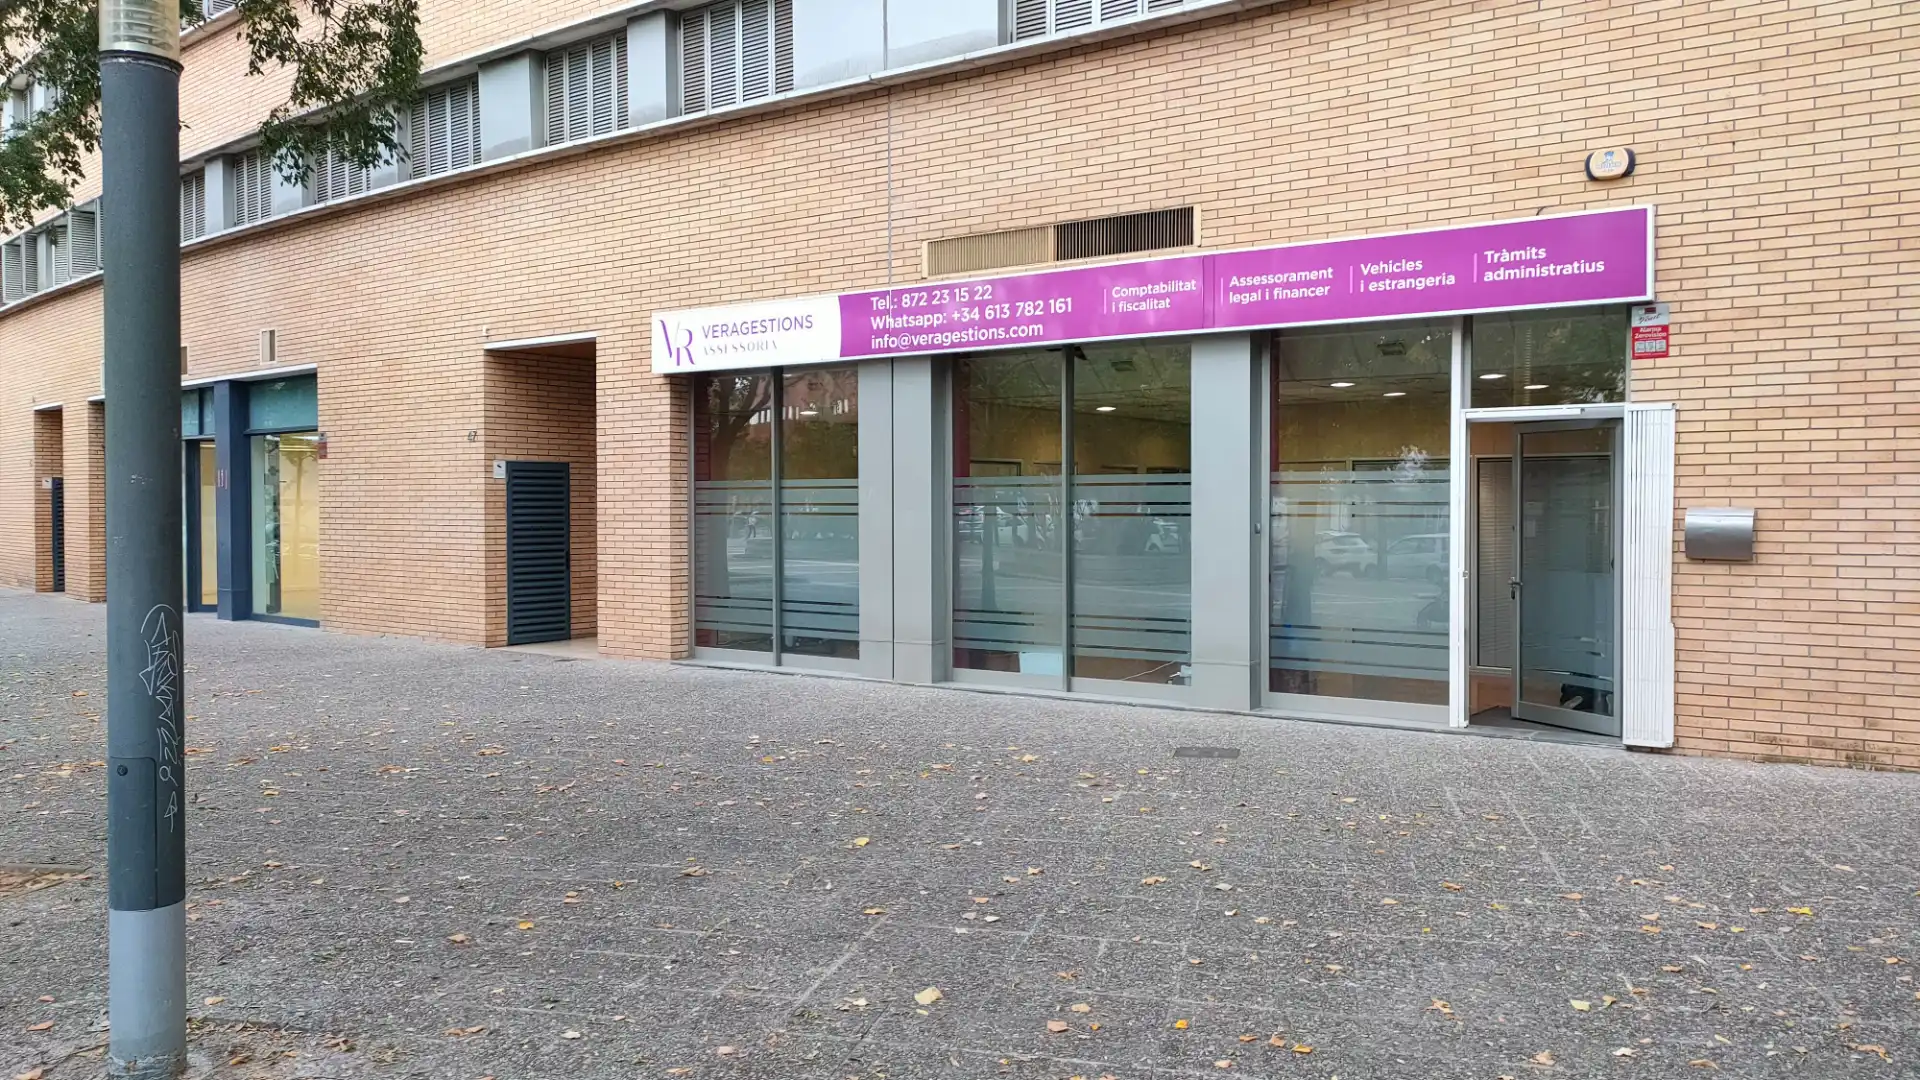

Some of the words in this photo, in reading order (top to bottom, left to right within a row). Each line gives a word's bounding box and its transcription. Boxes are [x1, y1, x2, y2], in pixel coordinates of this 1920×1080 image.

[1483, 247, 1547, 264] Tràmits
[1229, 267, 1334, 288] Assessorament
[1360, 259, 1423, 276] Vehicles
[1483, 260, 1605, 282] administratius
[1111, 279, 1197, 299] Comptabilitat
[1360, 279, 1365, 293] i
[1368, 271, 1456, 292] estrangeria
[901, 291, 928, 308] 872
[931, 289, 950, 305] 23
[953, 287, 969, 302] 15
[973, 284, 993, 300] 22
[1111, 300, 1116, 313] i
[1118, 297, 1171, 313] fiscalitat
[1229, 289, 1262, 305] legal
[1265, 287, 1270, 301] i
[1273, 284, 1331, 300] financer
[870, 312, 947, 330] Whatsapp:
[951, 306, 981, 322] +34
[984, 303, 1011, 320] 613
[1015, 300, 1045, 318] 782
[1048, 297, 1072, 314] 161
[701, 314, 814, 339] VERAGESTIONS
[871, 323, 1044, 350] info@veragestions.com
